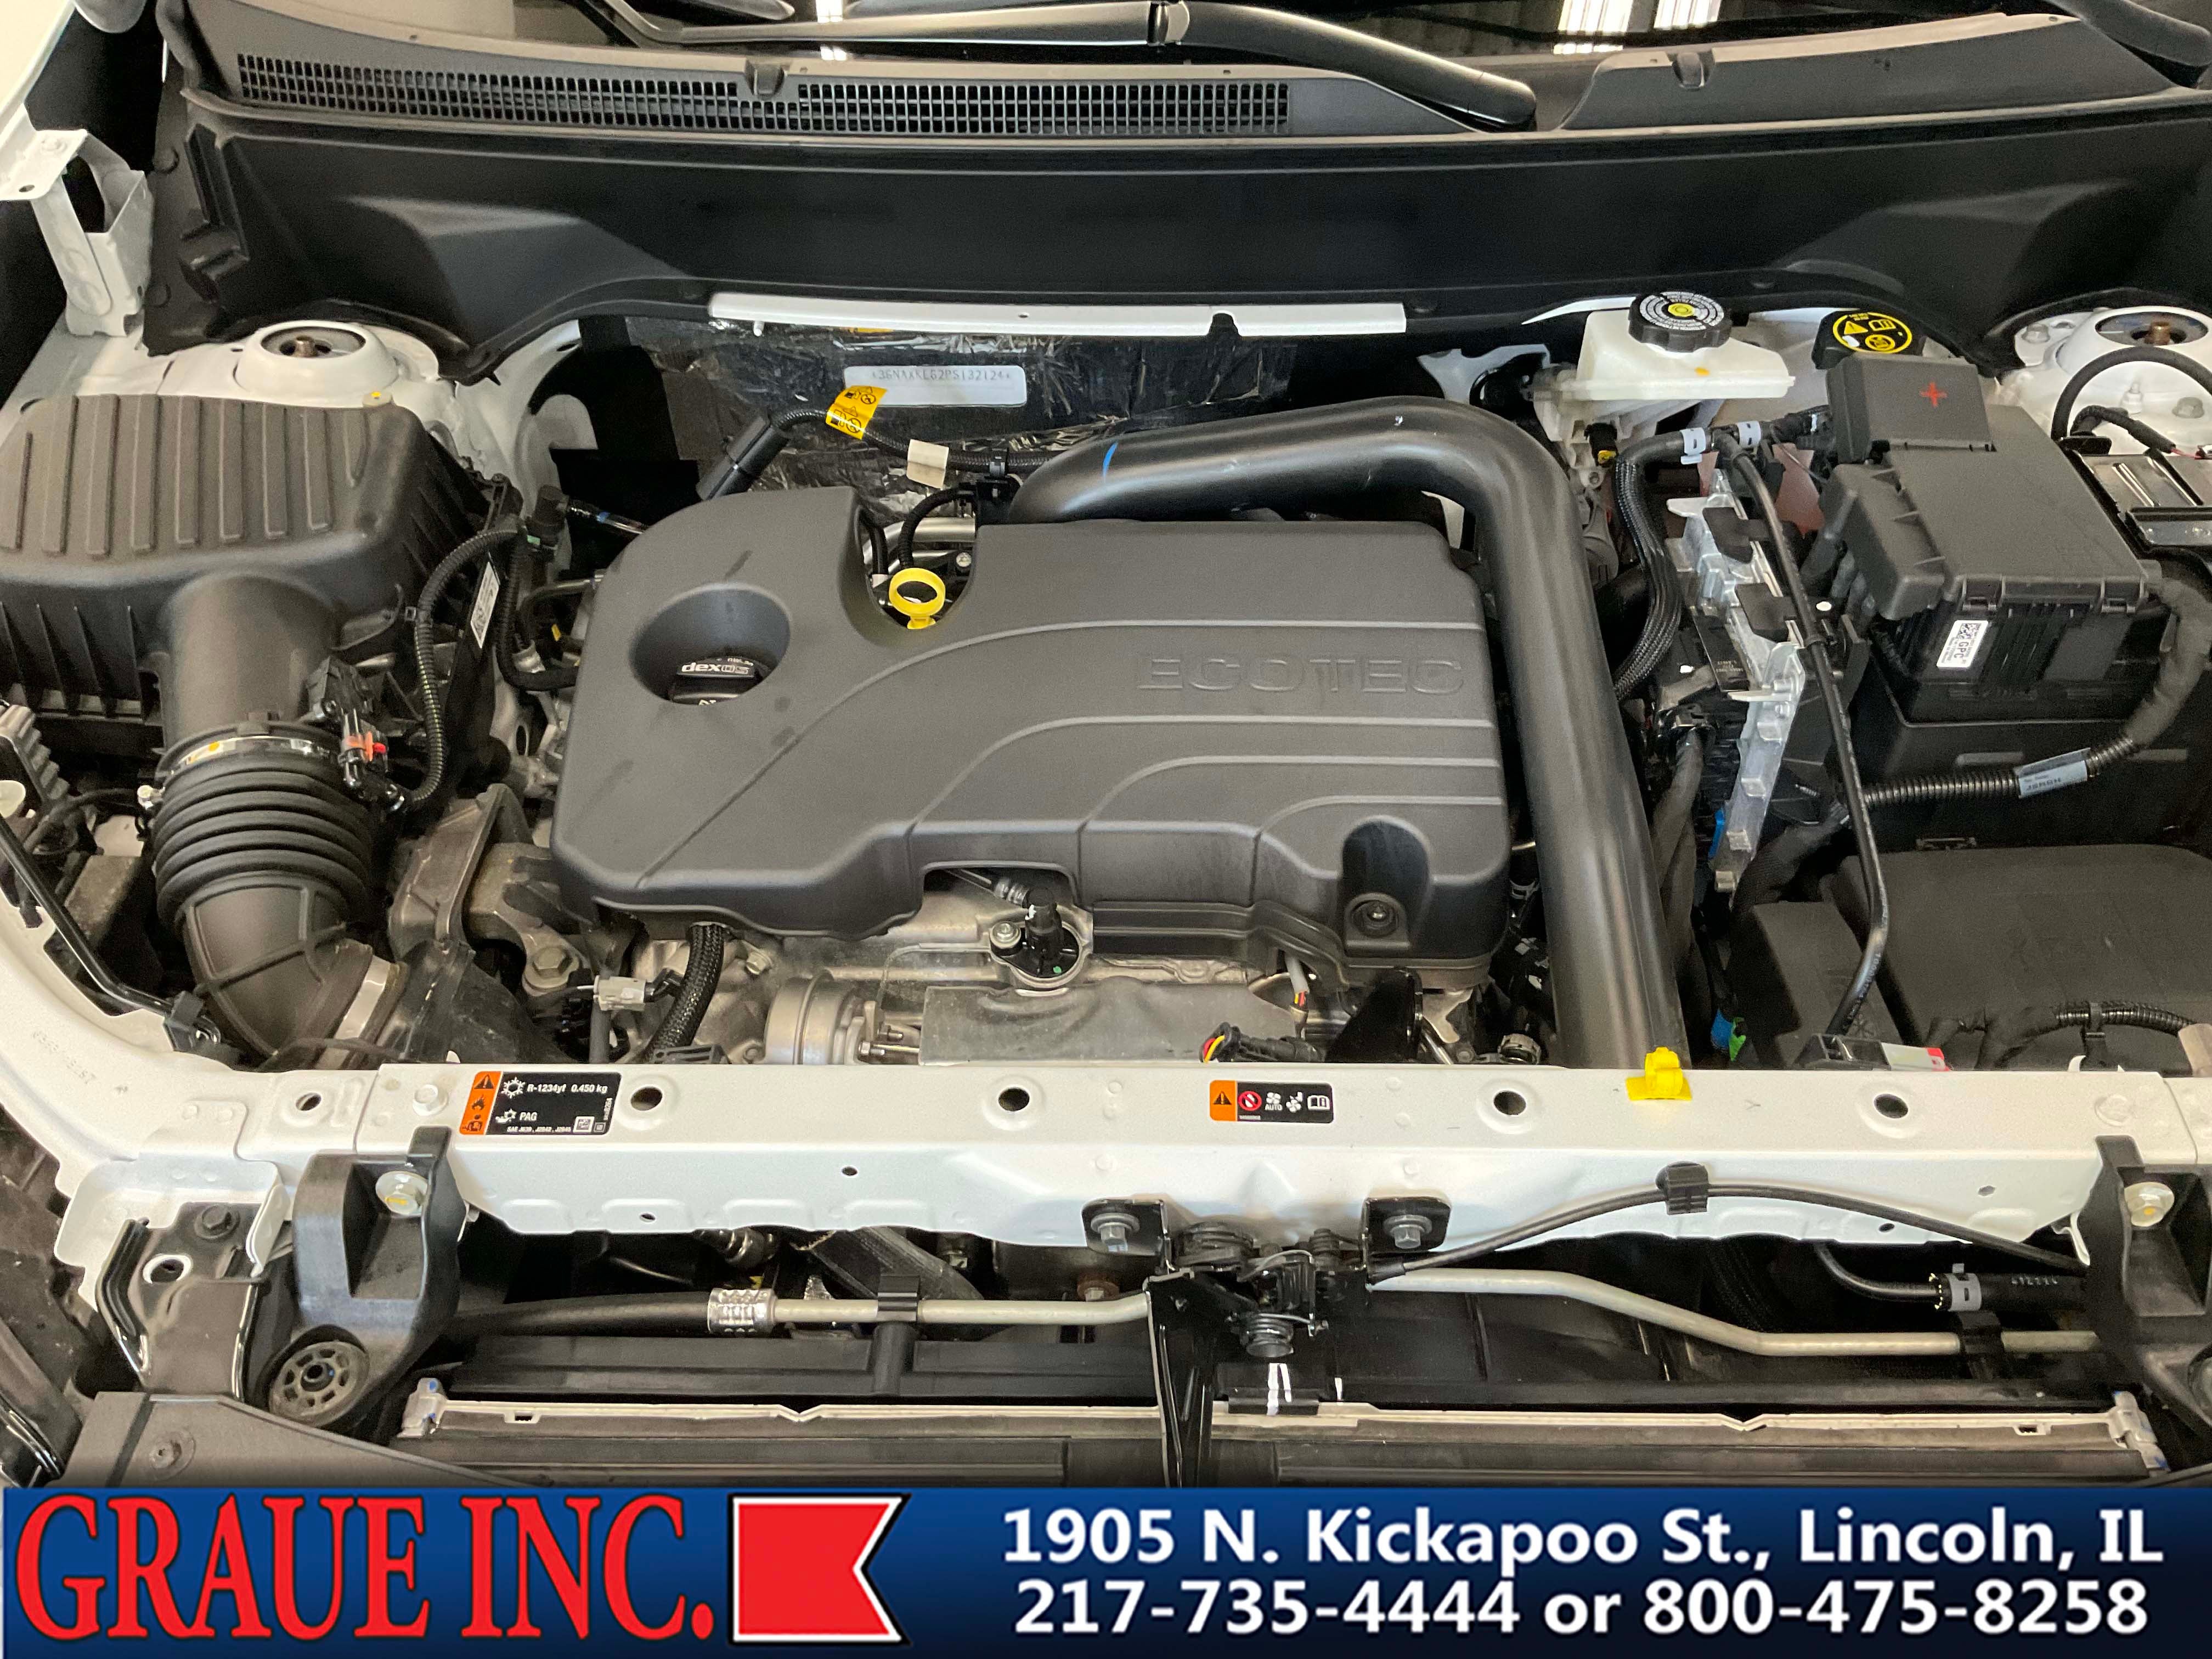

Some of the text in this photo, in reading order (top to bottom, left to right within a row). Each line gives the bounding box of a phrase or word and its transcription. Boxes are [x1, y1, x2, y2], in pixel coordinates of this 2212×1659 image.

[681, 662, 750, 674] dexos
[1137, 656, 1464, 695] ECOTEC
[527, 1084, 608, 1094] R-1234yf 0.450 kg
[519, 1111, 538, 1121] PAG
